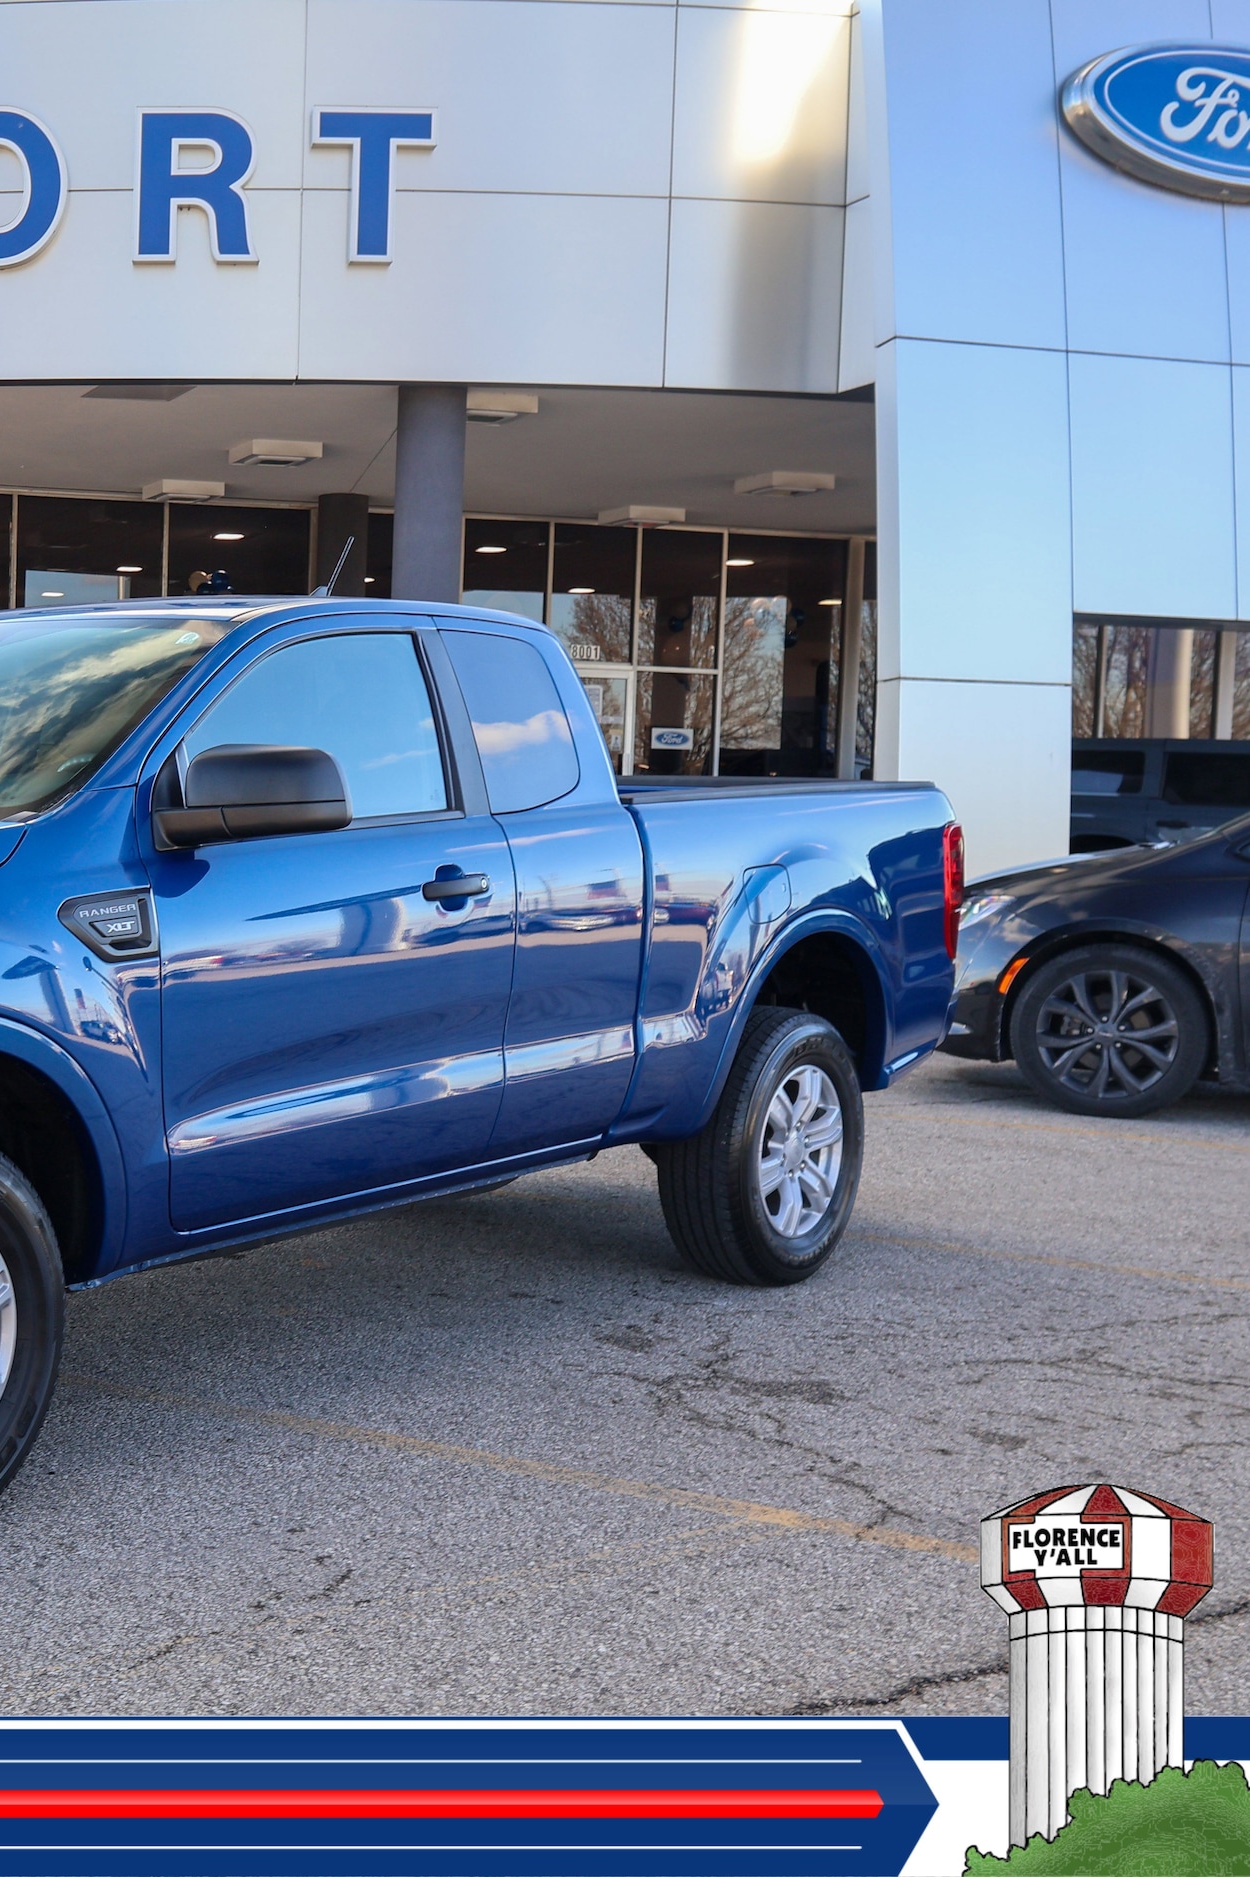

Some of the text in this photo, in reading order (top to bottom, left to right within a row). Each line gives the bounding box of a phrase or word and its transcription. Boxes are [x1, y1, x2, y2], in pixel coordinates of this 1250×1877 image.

[1160, 66, 1250, 150] Fo
[571, 645, 599, 659] 8001
[661, 732, 684, 745] Ford
[79, 903, 136, 918] RANGER
[106, 920, 135, 933] XLT
